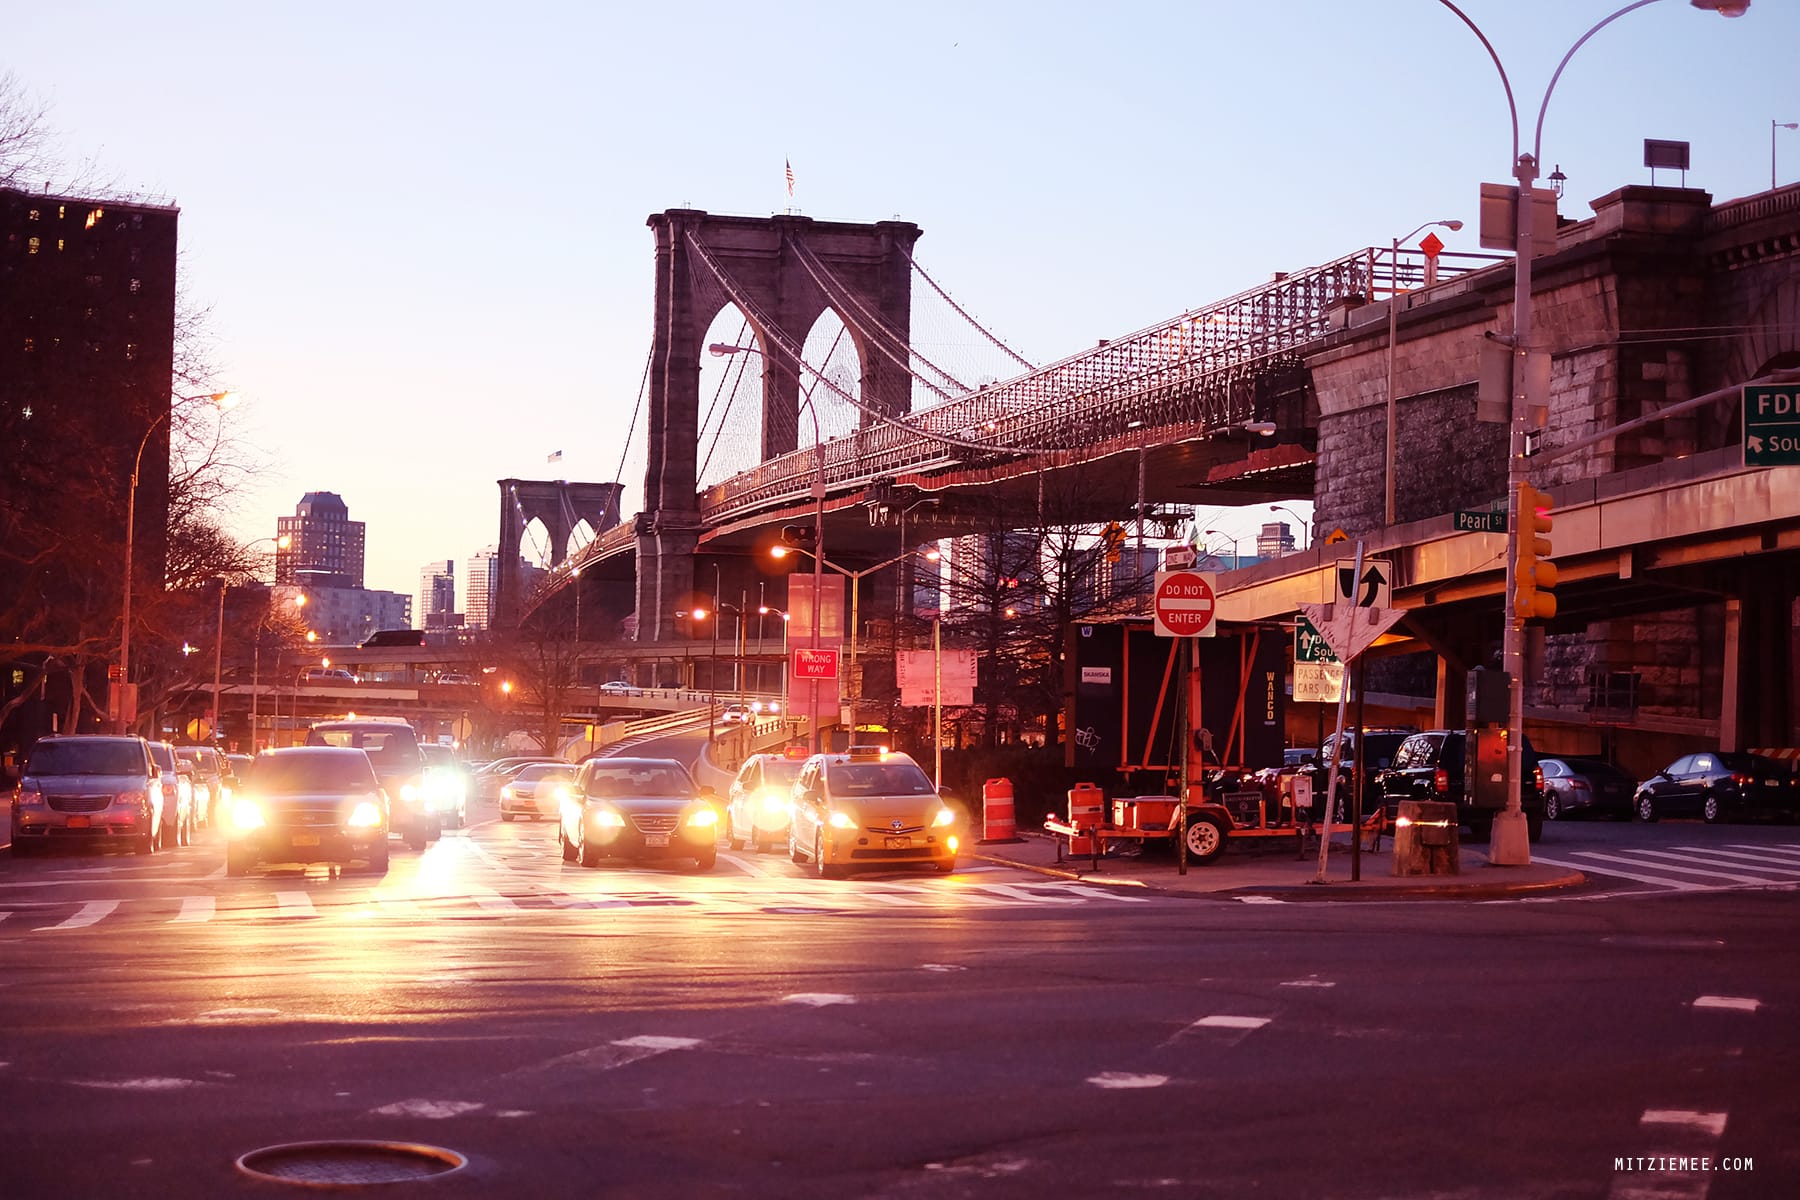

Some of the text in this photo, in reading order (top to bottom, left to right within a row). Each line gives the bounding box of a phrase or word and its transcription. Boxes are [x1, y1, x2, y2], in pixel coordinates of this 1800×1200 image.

[1460, 513, 1491, 530] Pearl
[1166, 585, 1204, 595] DO NOT
[1169, 613, 1202, 624] ENTER
[802, 655, 831, 664] WRONG
[807, 665, 825, 673] WAY
[1298, 683, 1341, 694] CARS ON
[1266, 672, 1275, 720] WANCO
